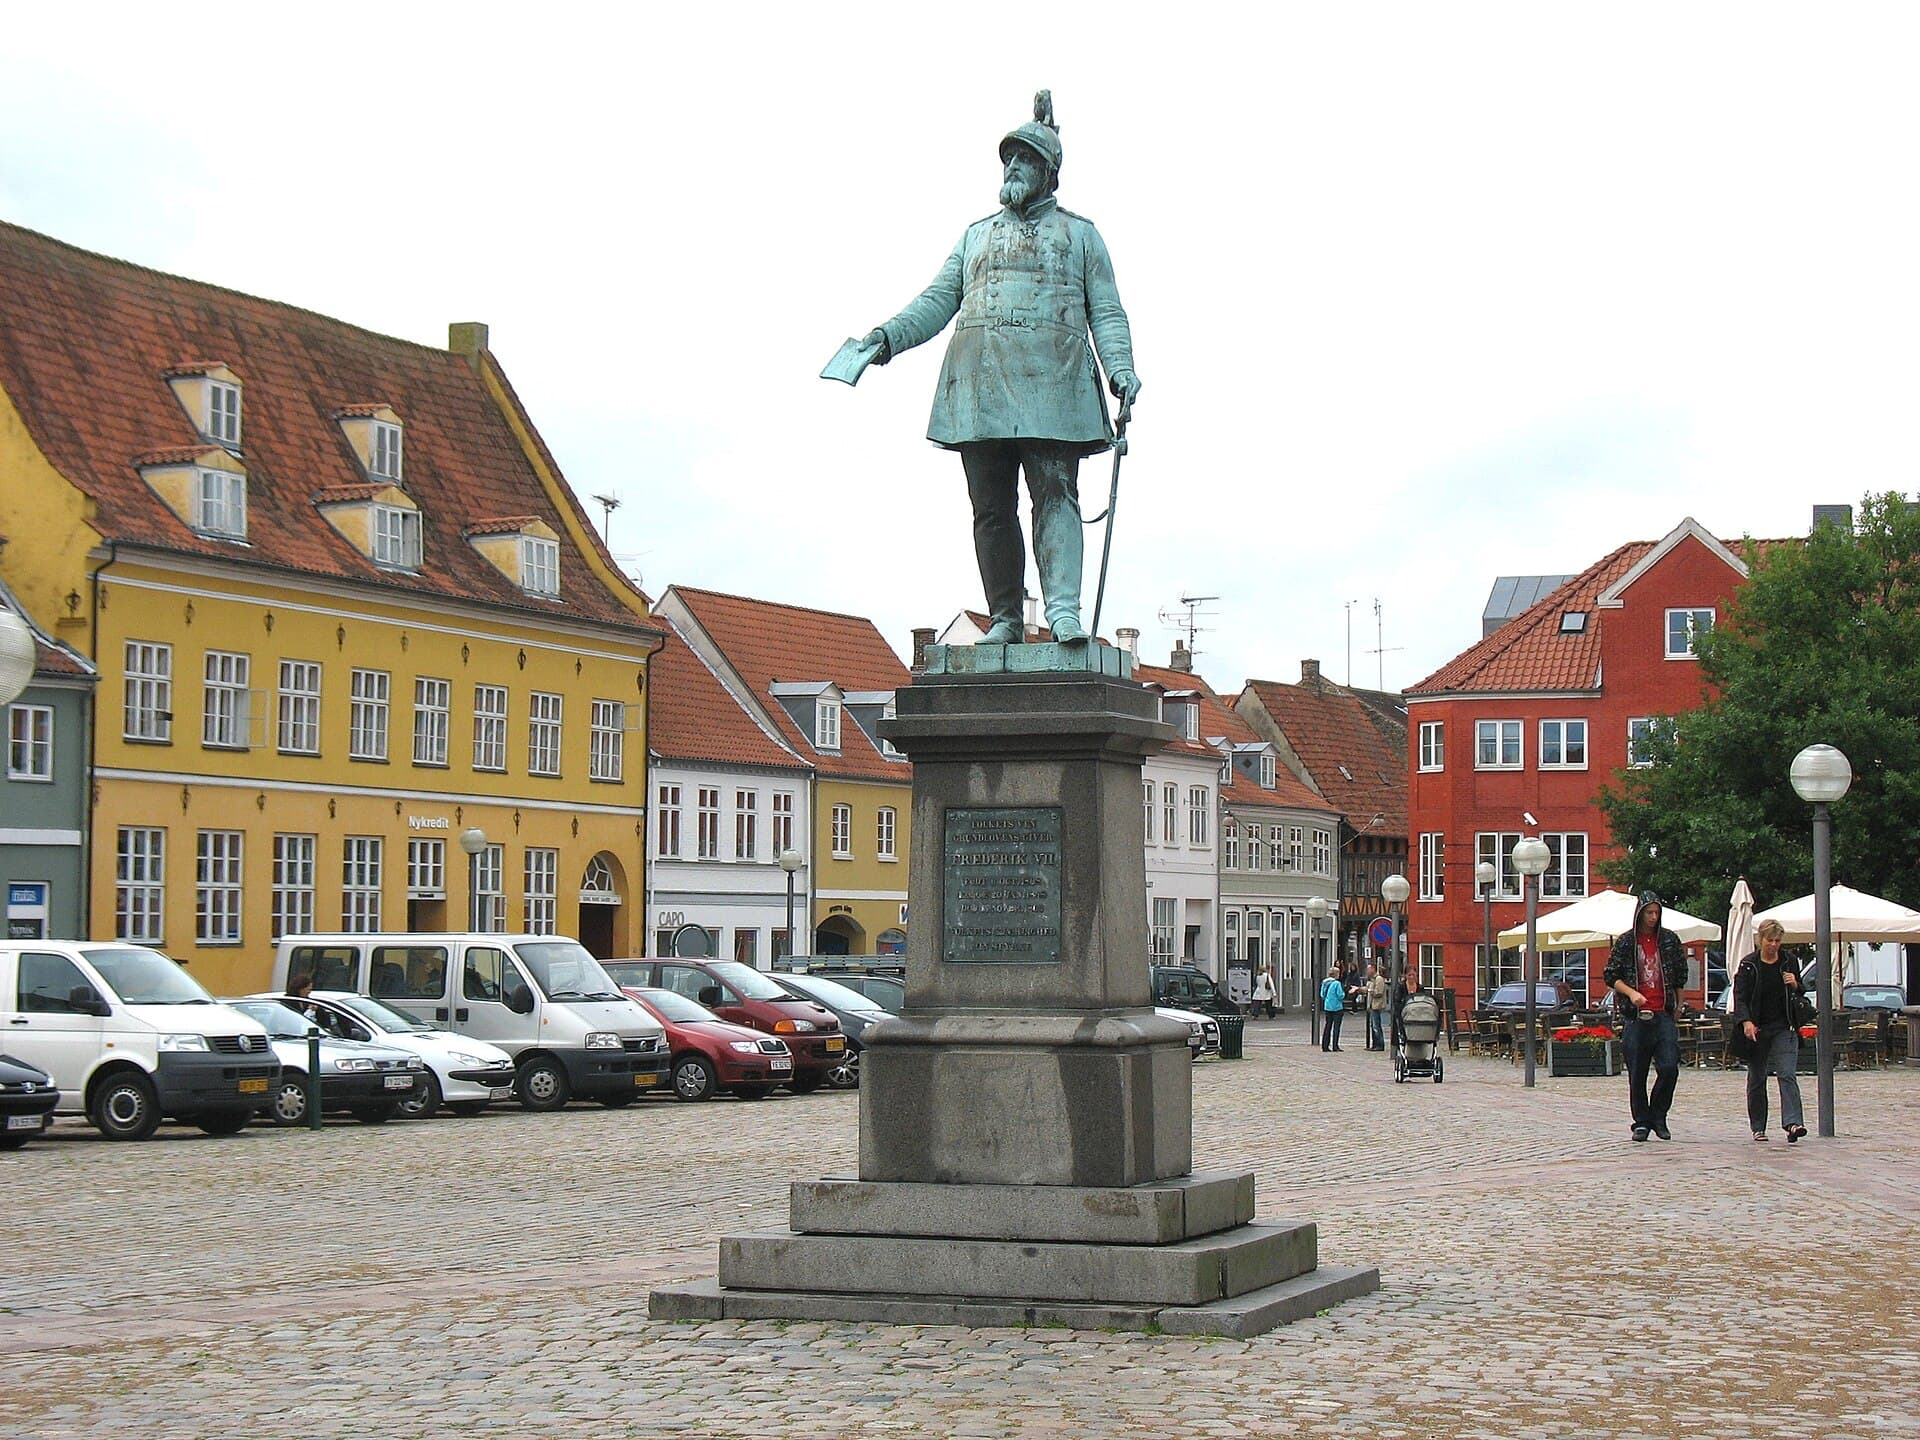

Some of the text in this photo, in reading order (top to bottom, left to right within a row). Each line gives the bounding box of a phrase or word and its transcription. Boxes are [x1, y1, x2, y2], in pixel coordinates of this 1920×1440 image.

[408, 815, 449, 829] Nykredit
[952, 853, 1055, 866] FREDERIK VII
[658, 911, 685, 926] CAPO
